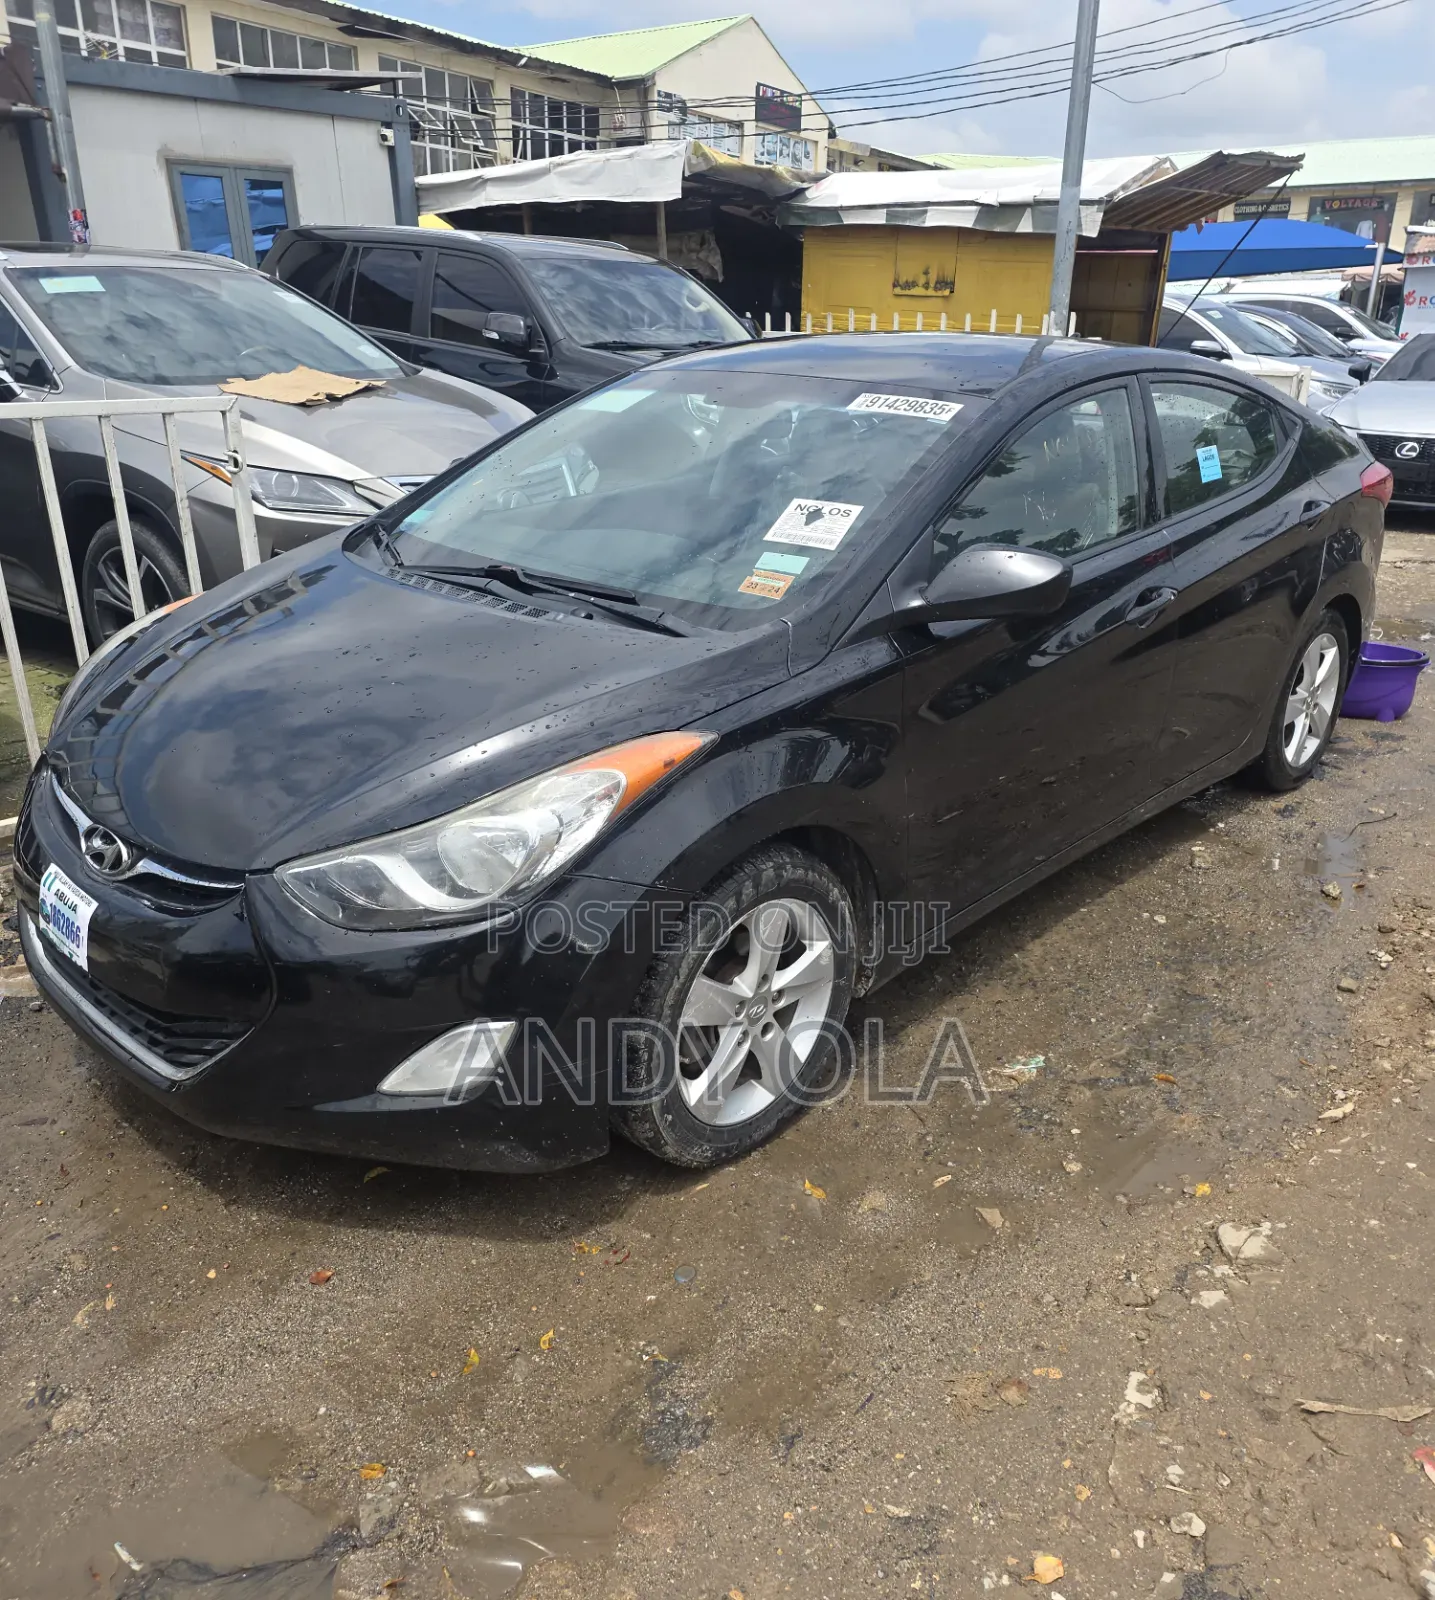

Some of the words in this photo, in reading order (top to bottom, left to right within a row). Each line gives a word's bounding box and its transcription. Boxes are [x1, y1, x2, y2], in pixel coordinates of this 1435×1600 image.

[1262, 203, 1289, 212] CSMETICS
[746, 581, 759, 590] 23
[54, 888, 78, 915] ABUJA
[49, 902, 81, 949] 1862866
